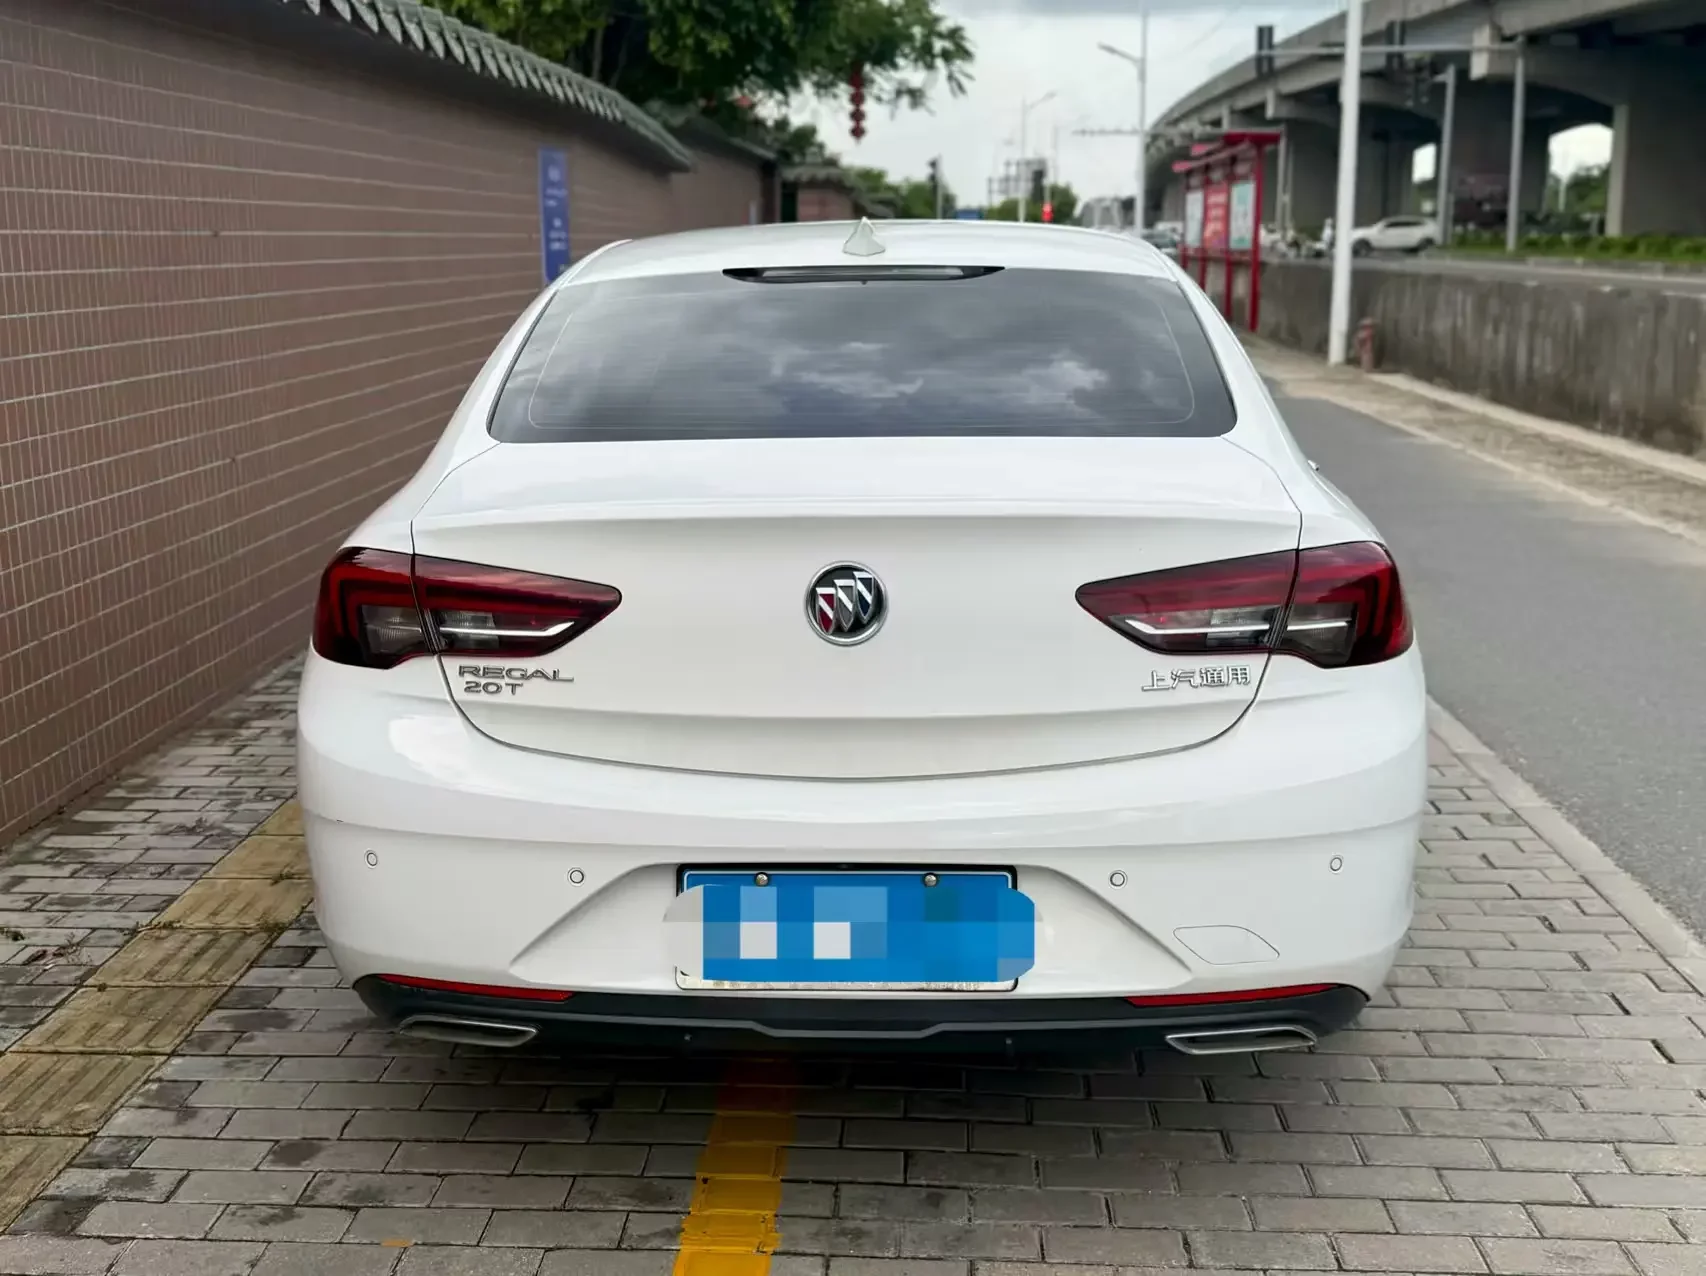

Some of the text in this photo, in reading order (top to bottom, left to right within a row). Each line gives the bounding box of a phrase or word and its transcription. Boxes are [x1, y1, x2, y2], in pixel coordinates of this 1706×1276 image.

[458, 665, 574, 682] REGAL
[1141, 665, 1250, 691] 上汽通用
[463, 680, 523, 695] 20T
